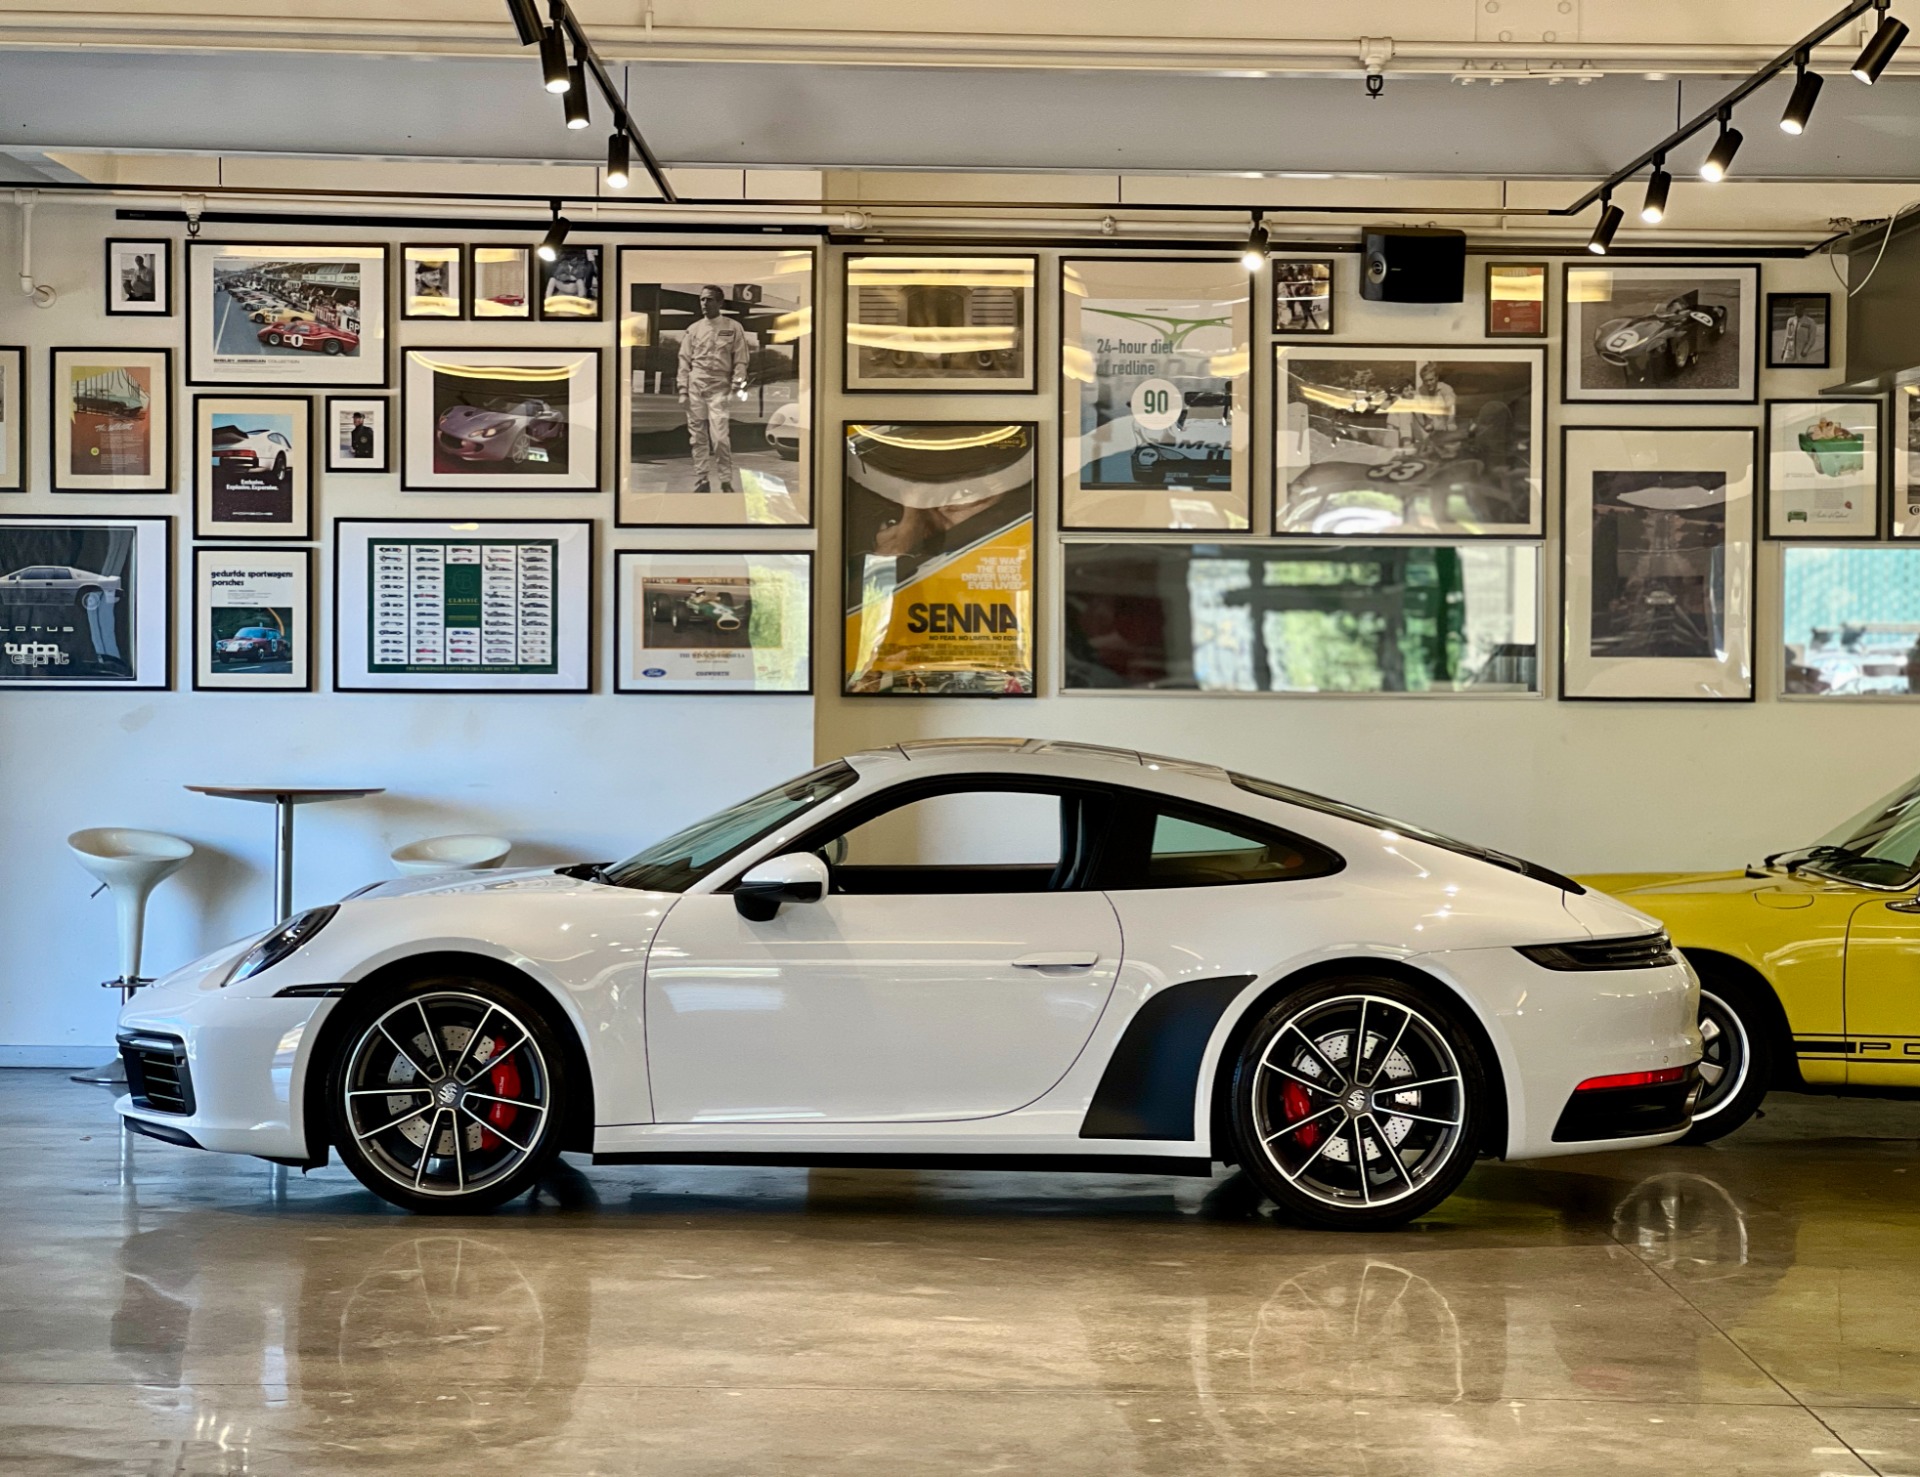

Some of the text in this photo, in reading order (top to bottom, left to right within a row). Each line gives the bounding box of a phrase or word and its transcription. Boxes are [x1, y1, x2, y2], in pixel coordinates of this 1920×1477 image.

[742, 284, 753, 301] 6
[294, 336, 299, 345] 1
[1096, 339, 1174, 354] 24-hour diet
[1611, 332, 1634, 348] 6
[1112, 360, 1156, 375] redline
[1144, 389, 1169, 414] 90
[1368, 461, 1424, 481] 33
[999, 557, 1022, 565] WAS
[211, 570, 293, 579] gedurfde sportwagens
[976, 565, 1022, 573] THE BEST
[212, 579, 244, 587] porsches
[961, 573, 1022, 581] DRIVER WHO
[968, 581, 993, 590] EVER
[907, 603, 1019, 634] SENNA
[4, 641, 60, 656] turbo
[11, 651, 70, 668] esprit
